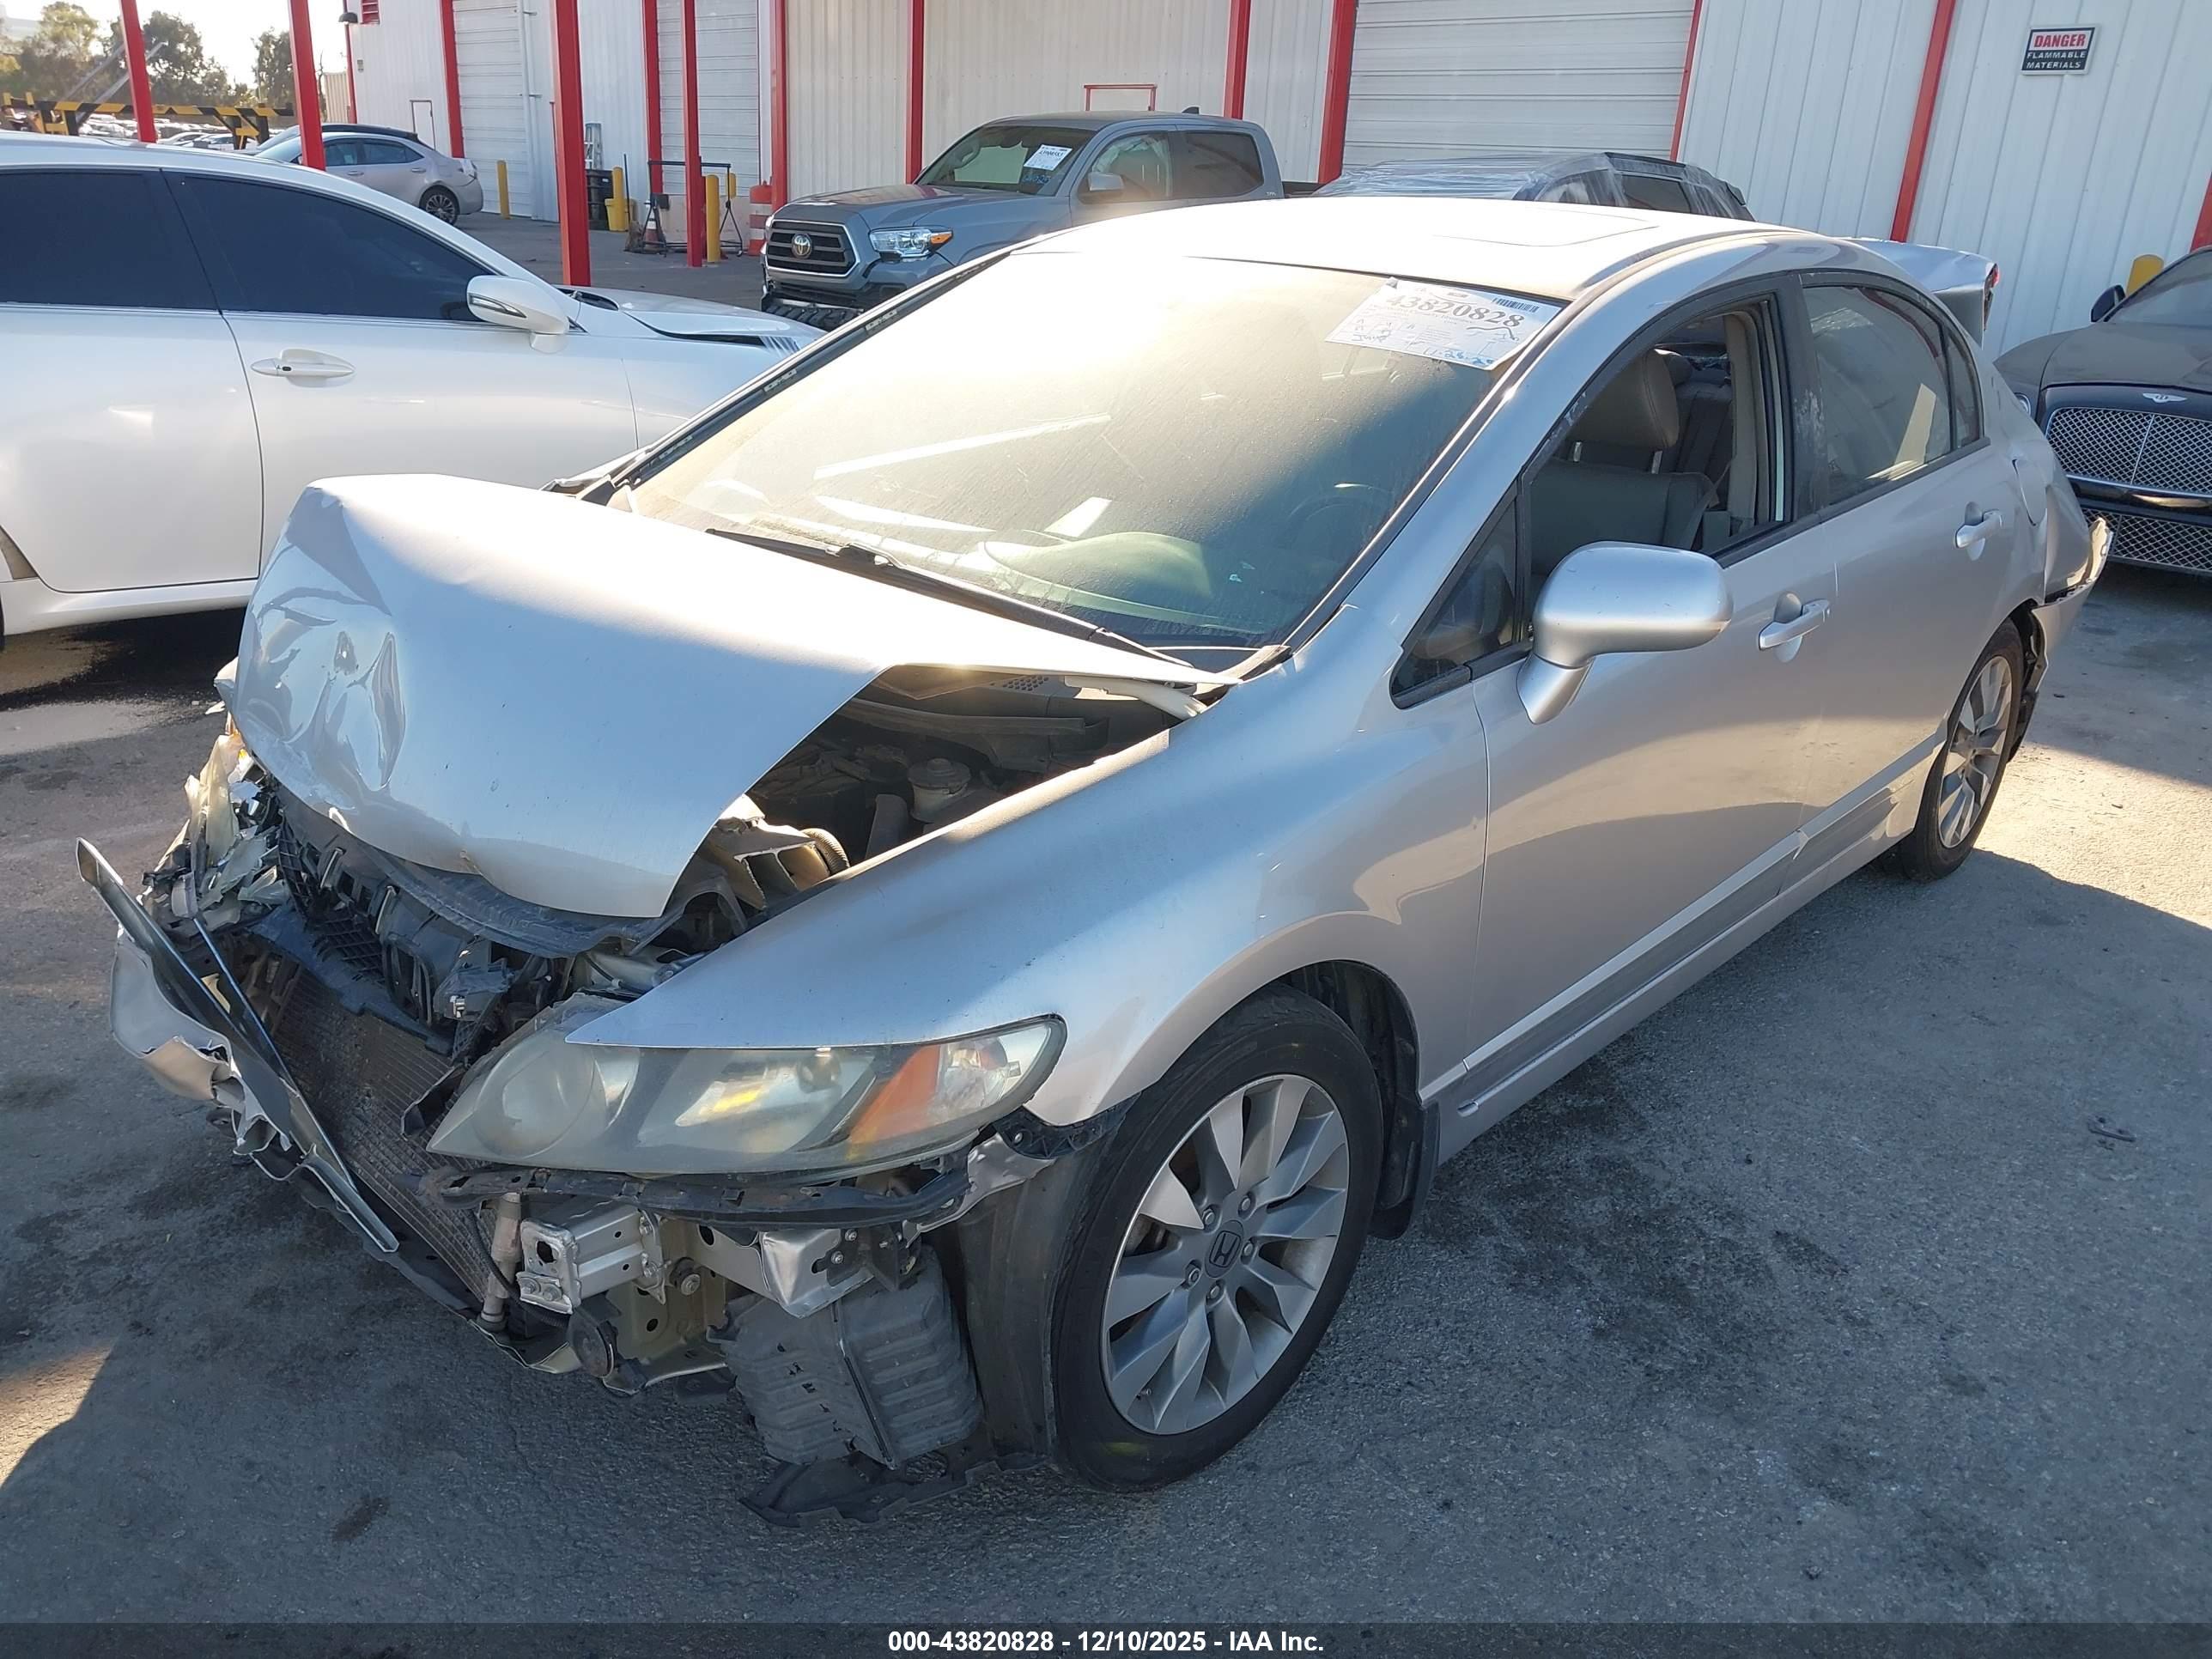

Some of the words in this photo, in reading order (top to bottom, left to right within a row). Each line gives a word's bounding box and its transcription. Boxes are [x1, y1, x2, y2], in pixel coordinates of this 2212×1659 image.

[2034, 33, 2087, 47] DANGER
[2027, 51, 2087, 59] FLAMMABLE
[2026, 61, 2081, 70] MATERIALS
[1386, 295, 1525, 328] 43820828
